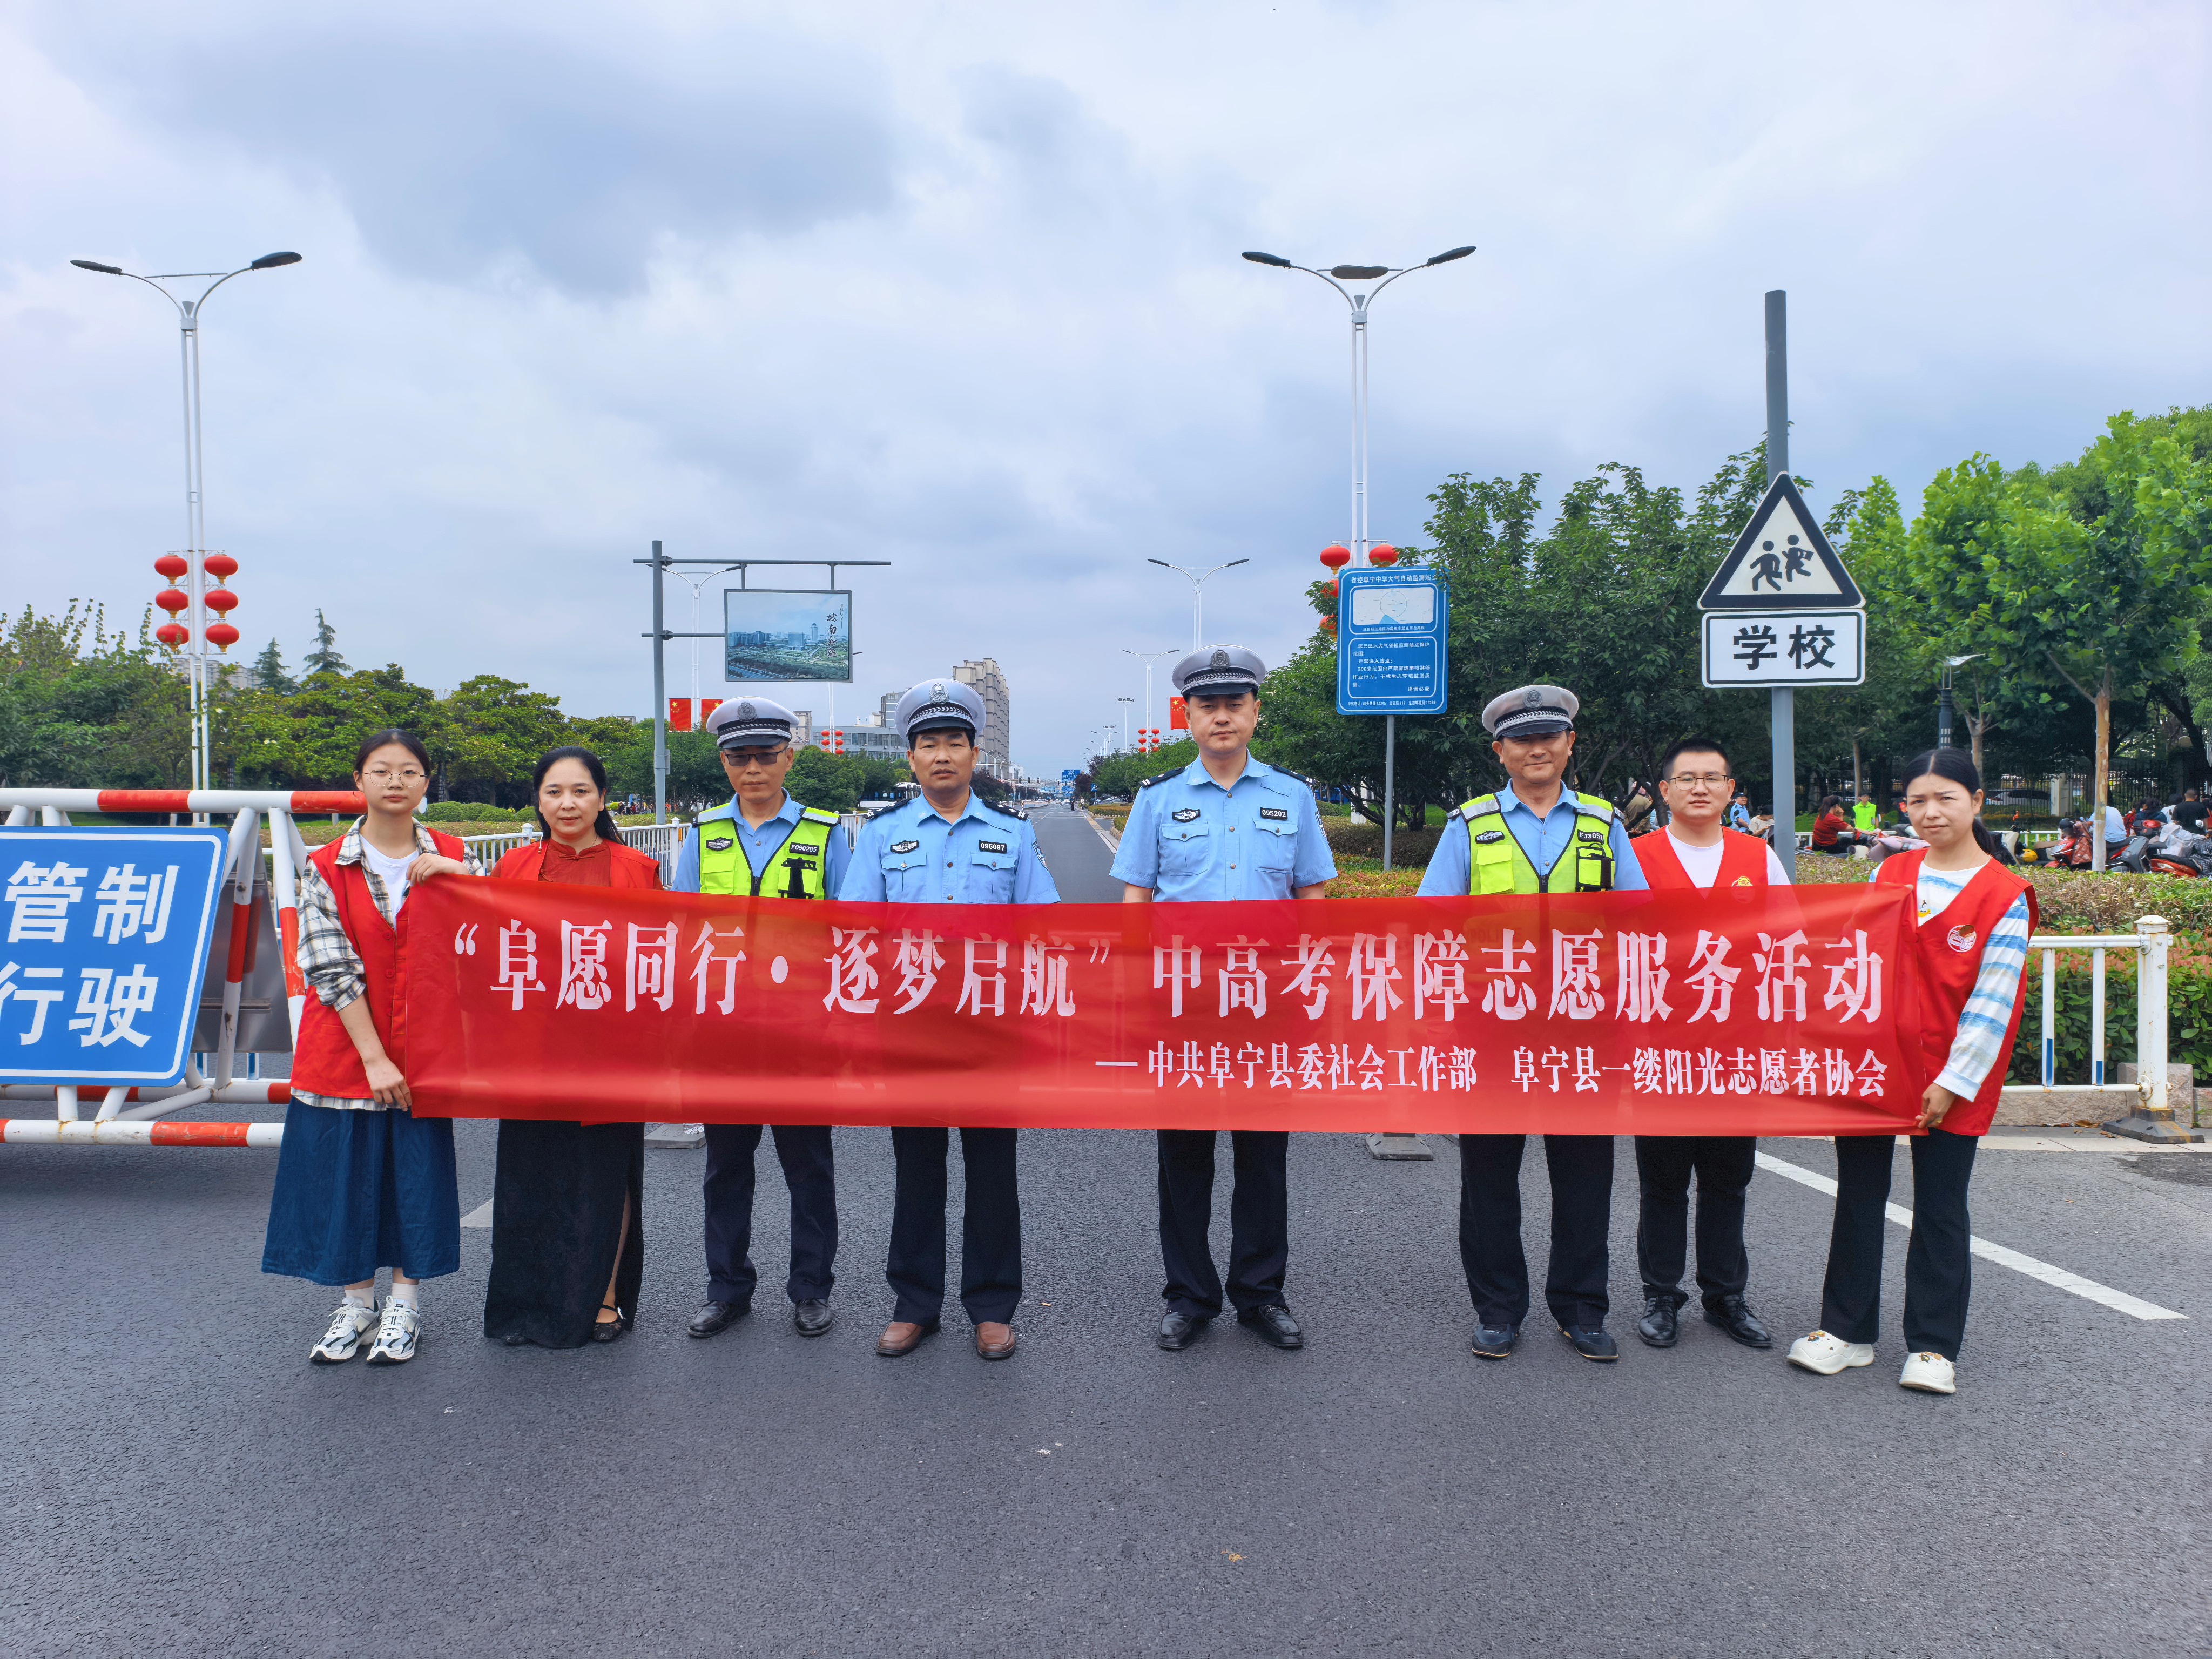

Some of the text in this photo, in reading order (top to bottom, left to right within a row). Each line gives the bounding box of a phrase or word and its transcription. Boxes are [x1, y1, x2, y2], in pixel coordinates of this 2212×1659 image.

[1733, 624, 1836, 670] 学校
[791, 844, 818, 852] F050285
[981, 842, 1004, 851] 095097
[4, 861, 180, 945] 管制
[0, 961, 159, 1048] 行驶
[1510, 1046, 1887, 1097] 阜宁县一缕阳光志愿者协会
